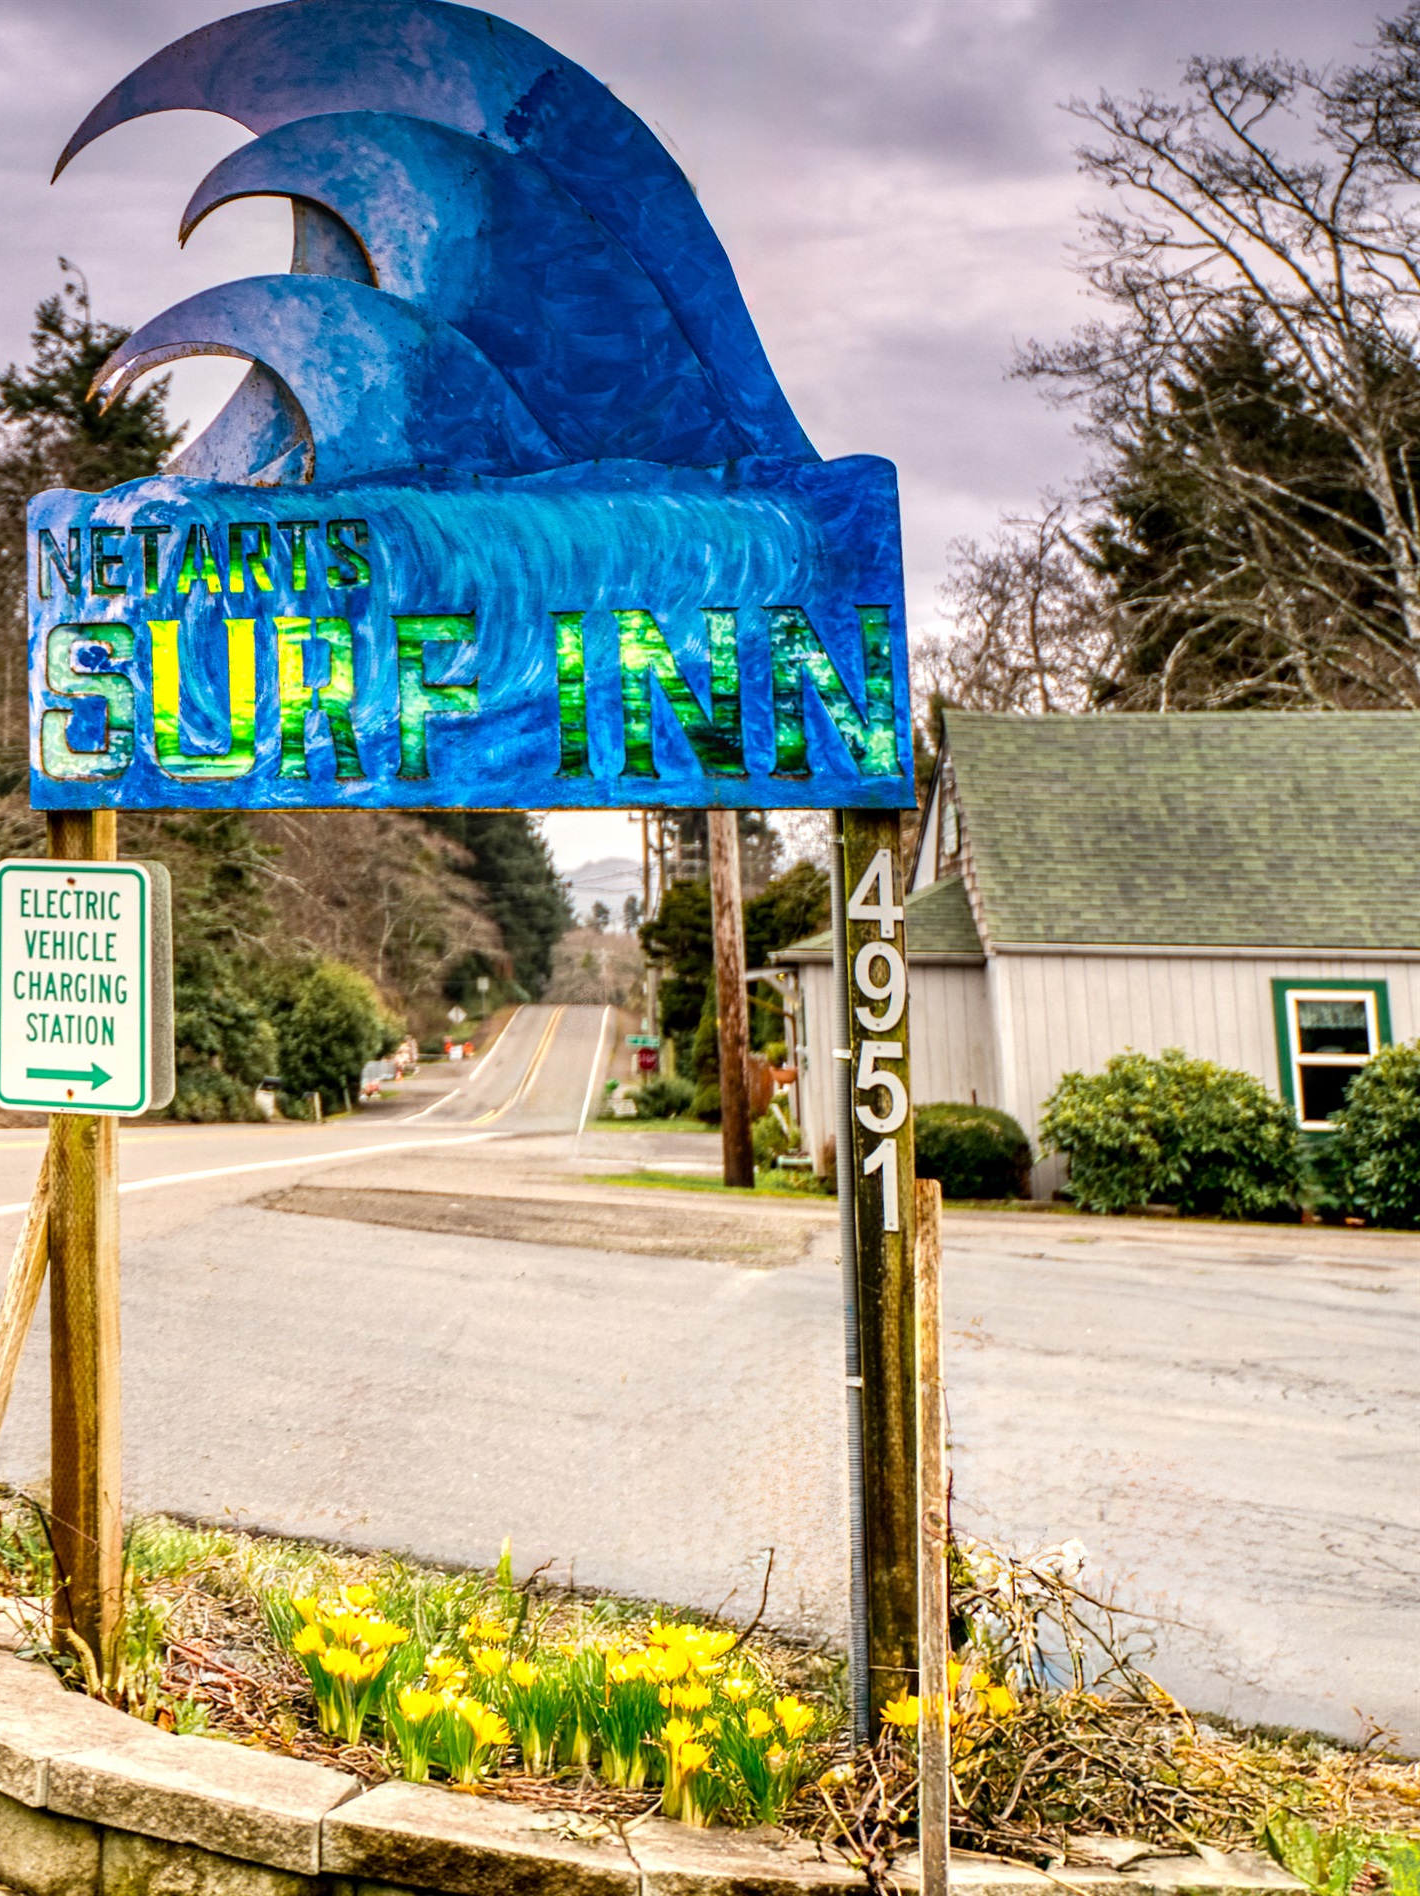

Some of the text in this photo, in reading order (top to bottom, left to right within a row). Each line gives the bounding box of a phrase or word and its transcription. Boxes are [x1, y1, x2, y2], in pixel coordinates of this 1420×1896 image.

[37, 518, 371, 599] NETARTS
[40, 604, 905, 782] SURF INN
[20, 888, 121, 921] ELECTRIC
[24, 930, 117, 962] VEHICLE
[13, 970, 128, 1004] CHARGING
[26, 1013, 115, 1046] STATION
[847, 848, 909, 1232] 4951
